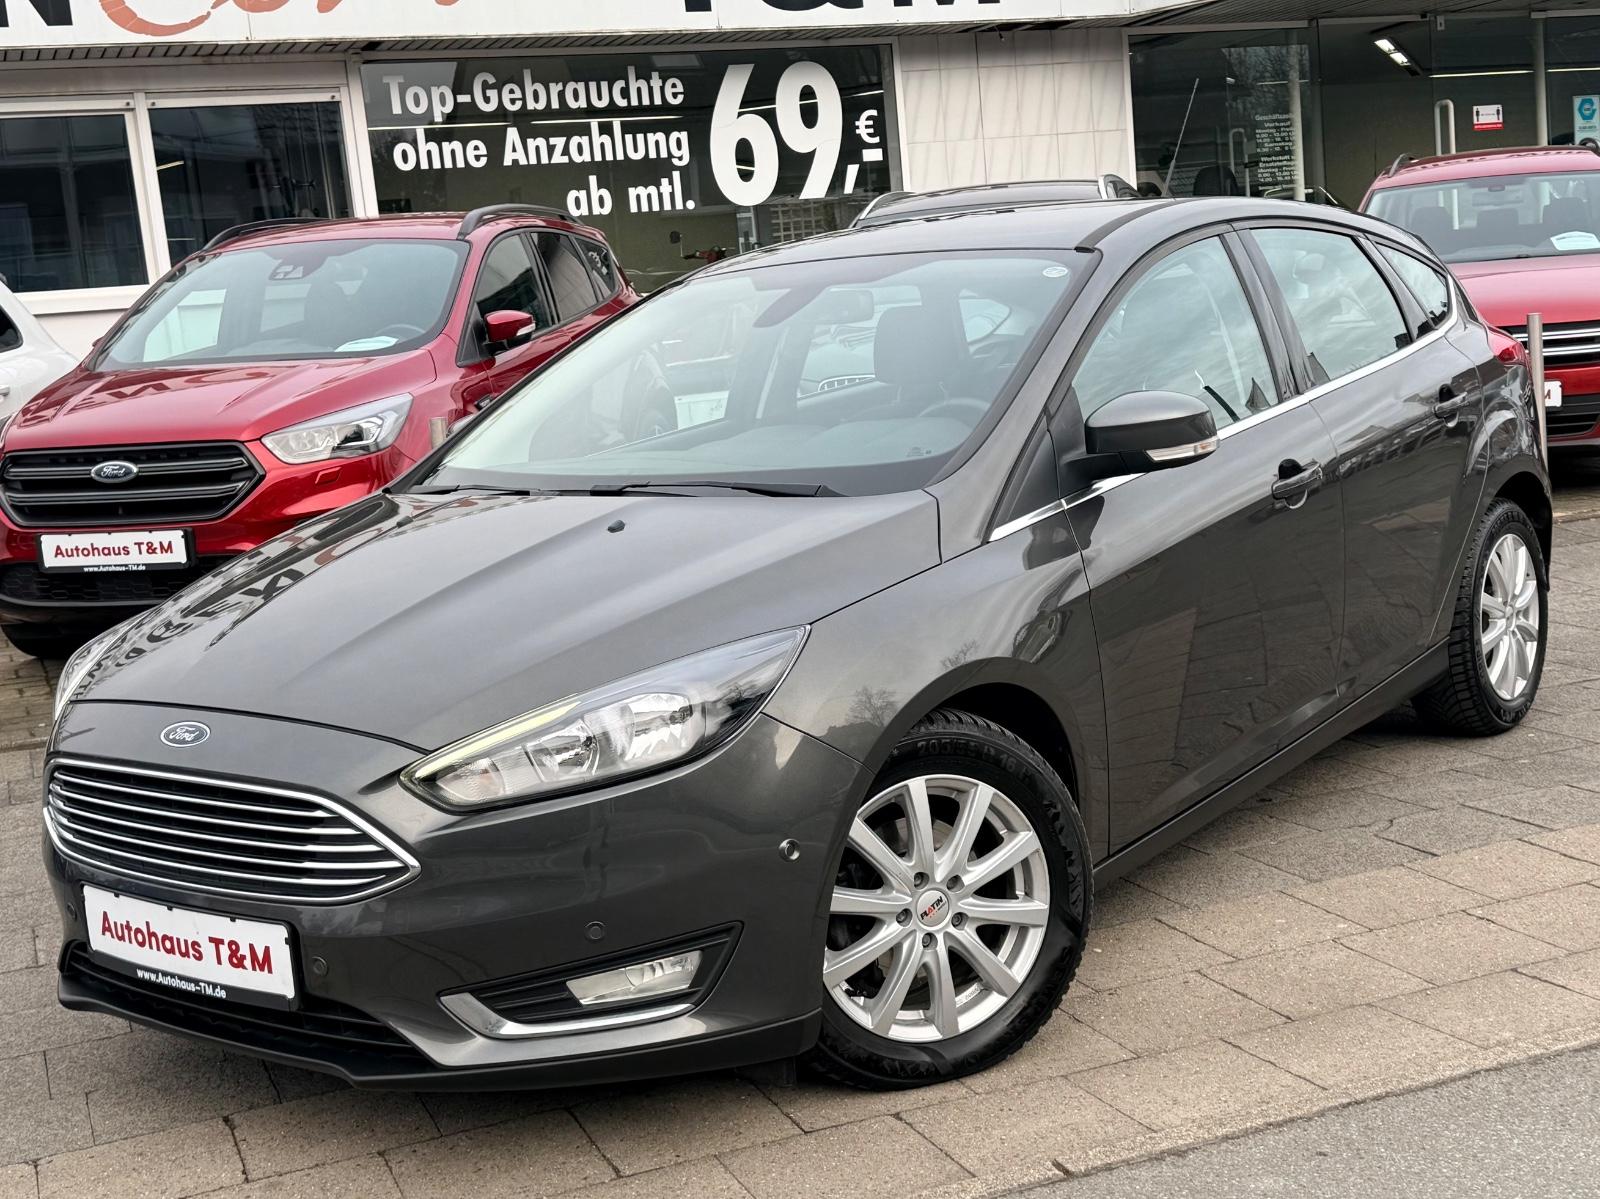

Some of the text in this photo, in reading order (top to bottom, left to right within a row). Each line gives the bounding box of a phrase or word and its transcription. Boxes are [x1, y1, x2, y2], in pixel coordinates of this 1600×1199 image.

[382, 65, 684, 122] Top-Gebrauchte
[855, 109, 880, 143] €
[393, 120, 690, 171] ohne Anzahlung
[566, 170, 695, 217] ab mtl.
[101, 464, 126, 477] Ford
[54, 541, 173, 558] Autohaus T&M
[83, 564, 146, 572] www.Autohaus-TM.de
[169, 726, 197, 742] Ford
[101, 911, 273, 974] Autohaus T&M
[136, 968, 227, 999] www.Autohaus-TM.de
